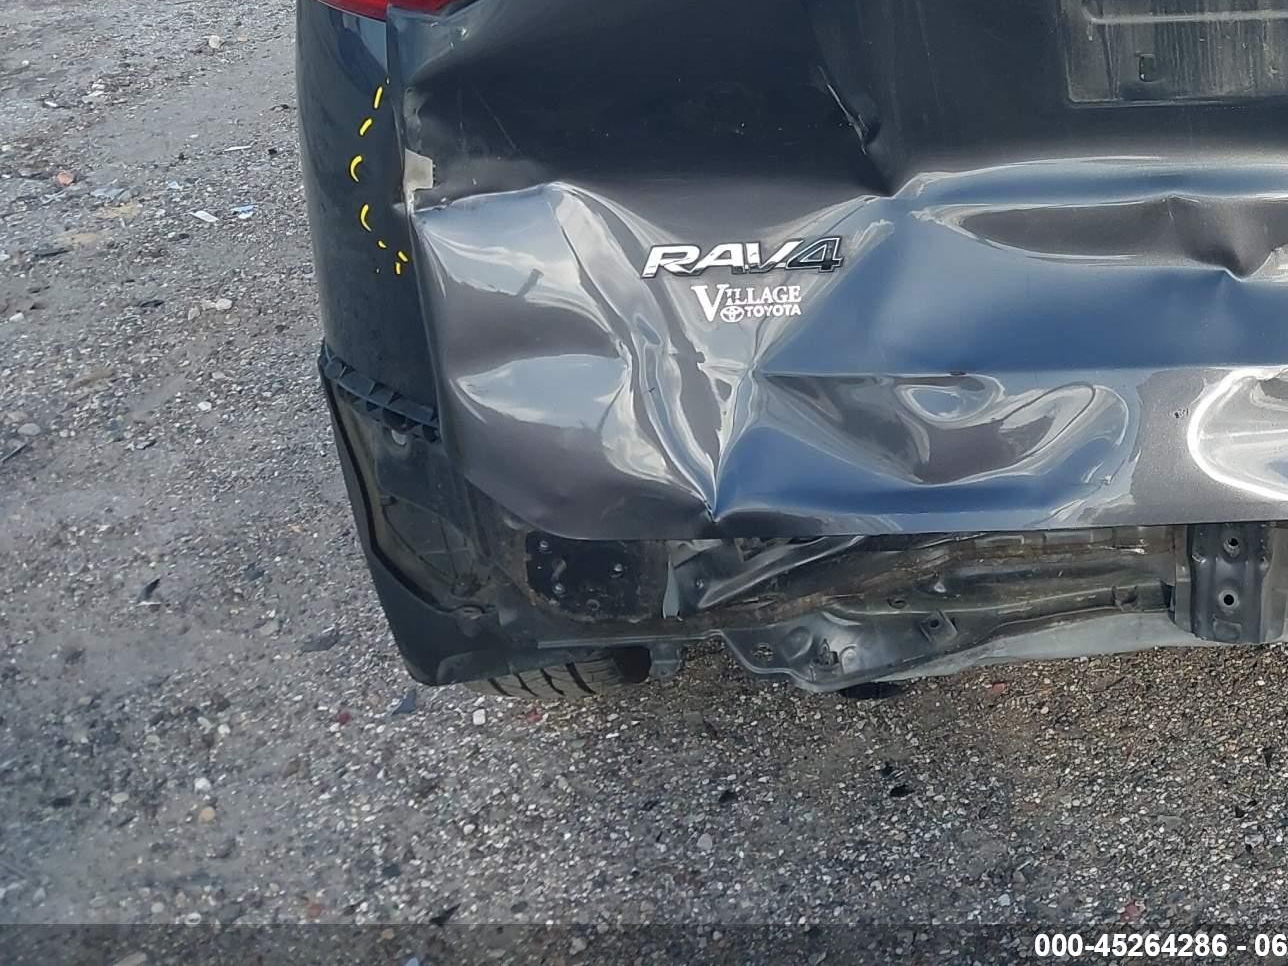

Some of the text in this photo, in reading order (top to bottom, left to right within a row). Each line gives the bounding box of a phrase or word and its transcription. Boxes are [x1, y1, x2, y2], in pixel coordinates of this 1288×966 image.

[640, 236, 844, 279] RAV4
[690, 284, 802, 322] VILLAGE
[744, 305, 802, 318] TOYOTA
